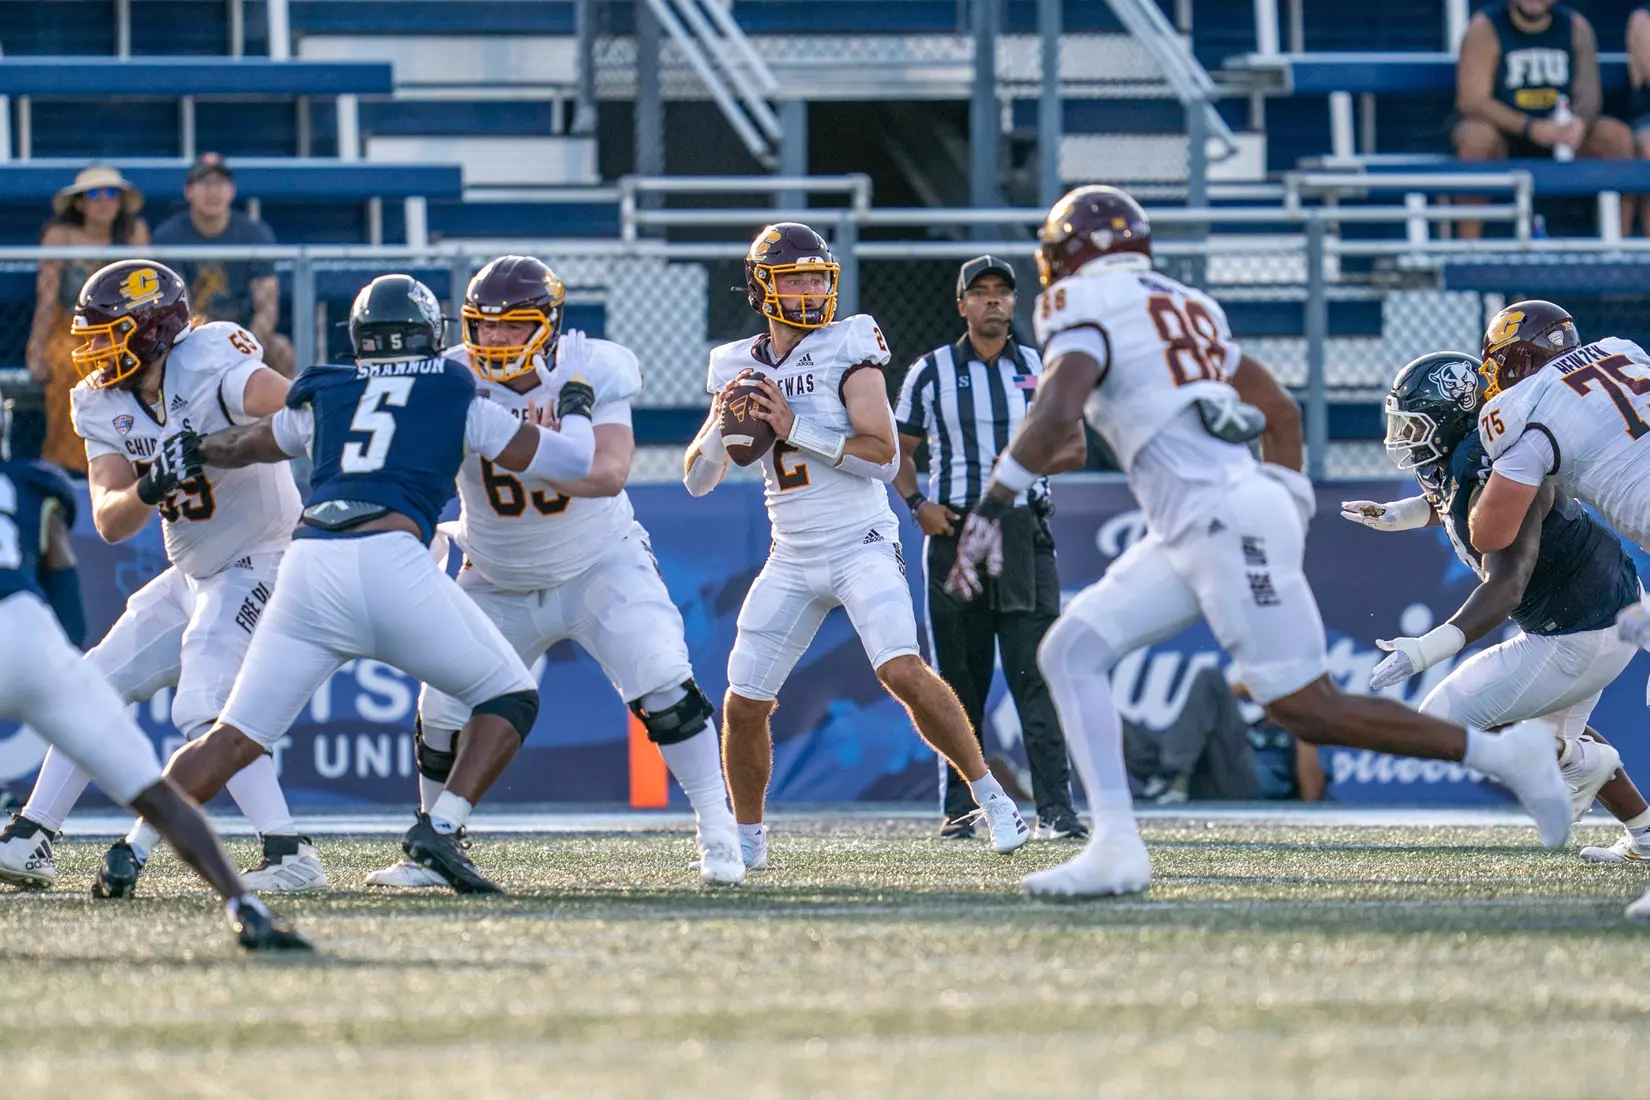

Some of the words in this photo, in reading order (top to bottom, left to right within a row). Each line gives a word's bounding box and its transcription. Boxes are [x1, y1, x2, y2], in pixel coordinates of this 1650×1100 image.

[1505, 47, 1570, 89] FIU
[228, 329, 259, 355] 59
[389, 333, 403, 350] 5
[356, 358, 446, 380] SHANNON
[958, 375, 970, 388] S
[340, 375, 416, 474] 5
[1481, 408, 1506, 442] 75
[235, 596, 262, 635] FIRE
